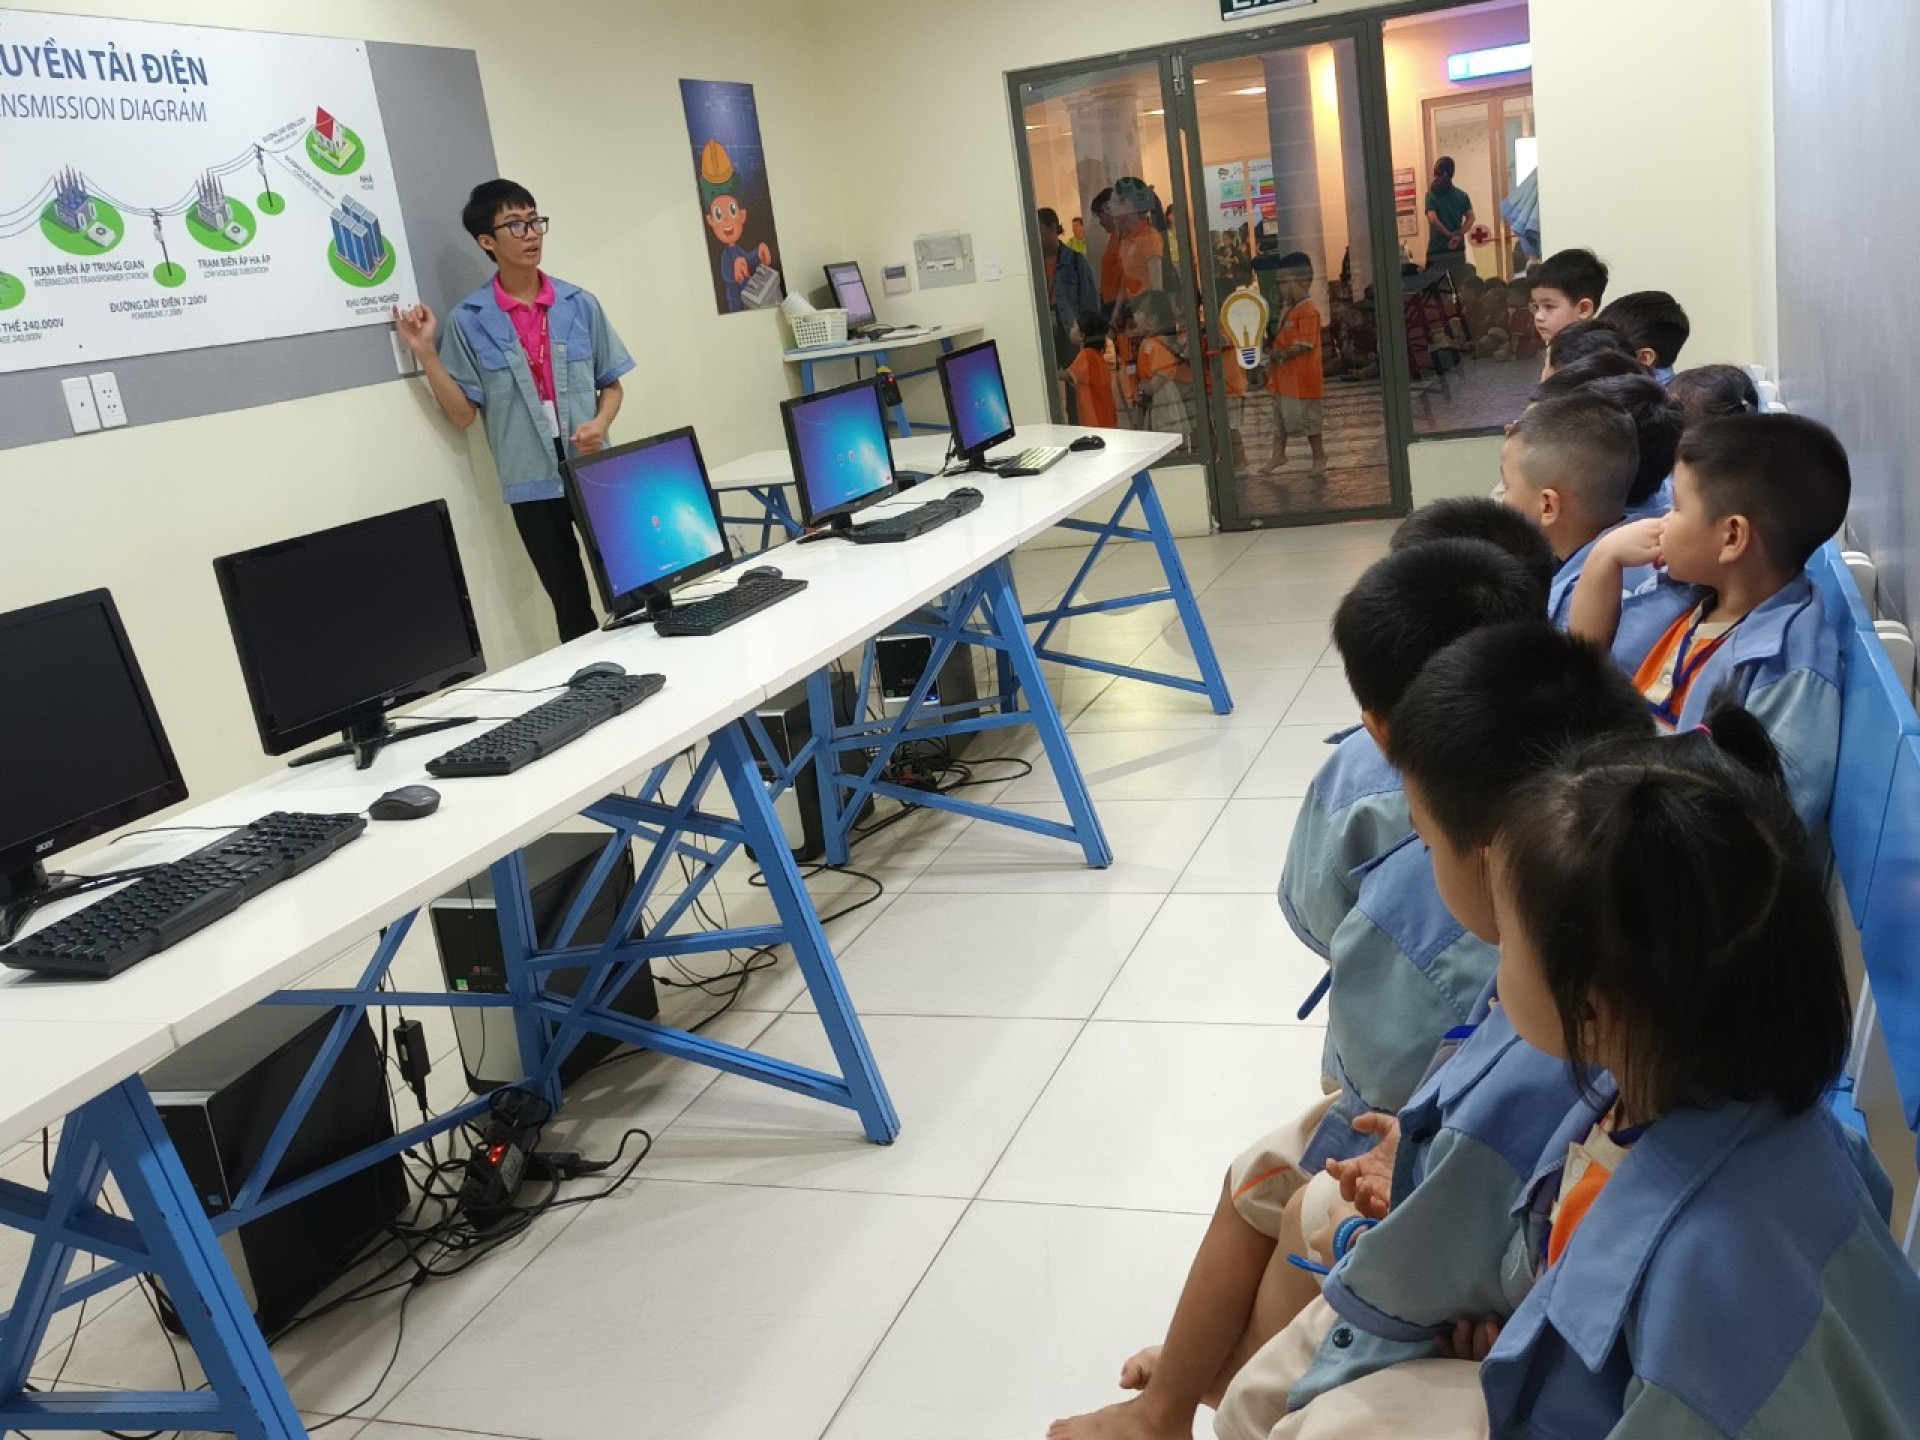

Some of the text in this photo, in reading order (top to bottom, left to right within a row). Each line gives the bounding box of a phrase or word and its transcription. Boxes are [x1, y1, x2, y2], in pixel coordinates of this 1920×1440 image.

[0, 37, 209, 93] UYỀN TẢI ĐIỆN
[0, 93, 208, 122] NSMISSION DIAGRAM
[92, 261, 123, 273] TRUNG
[124, 260, 145, 271] GIAN
[35, 838, 55, 853] acer
